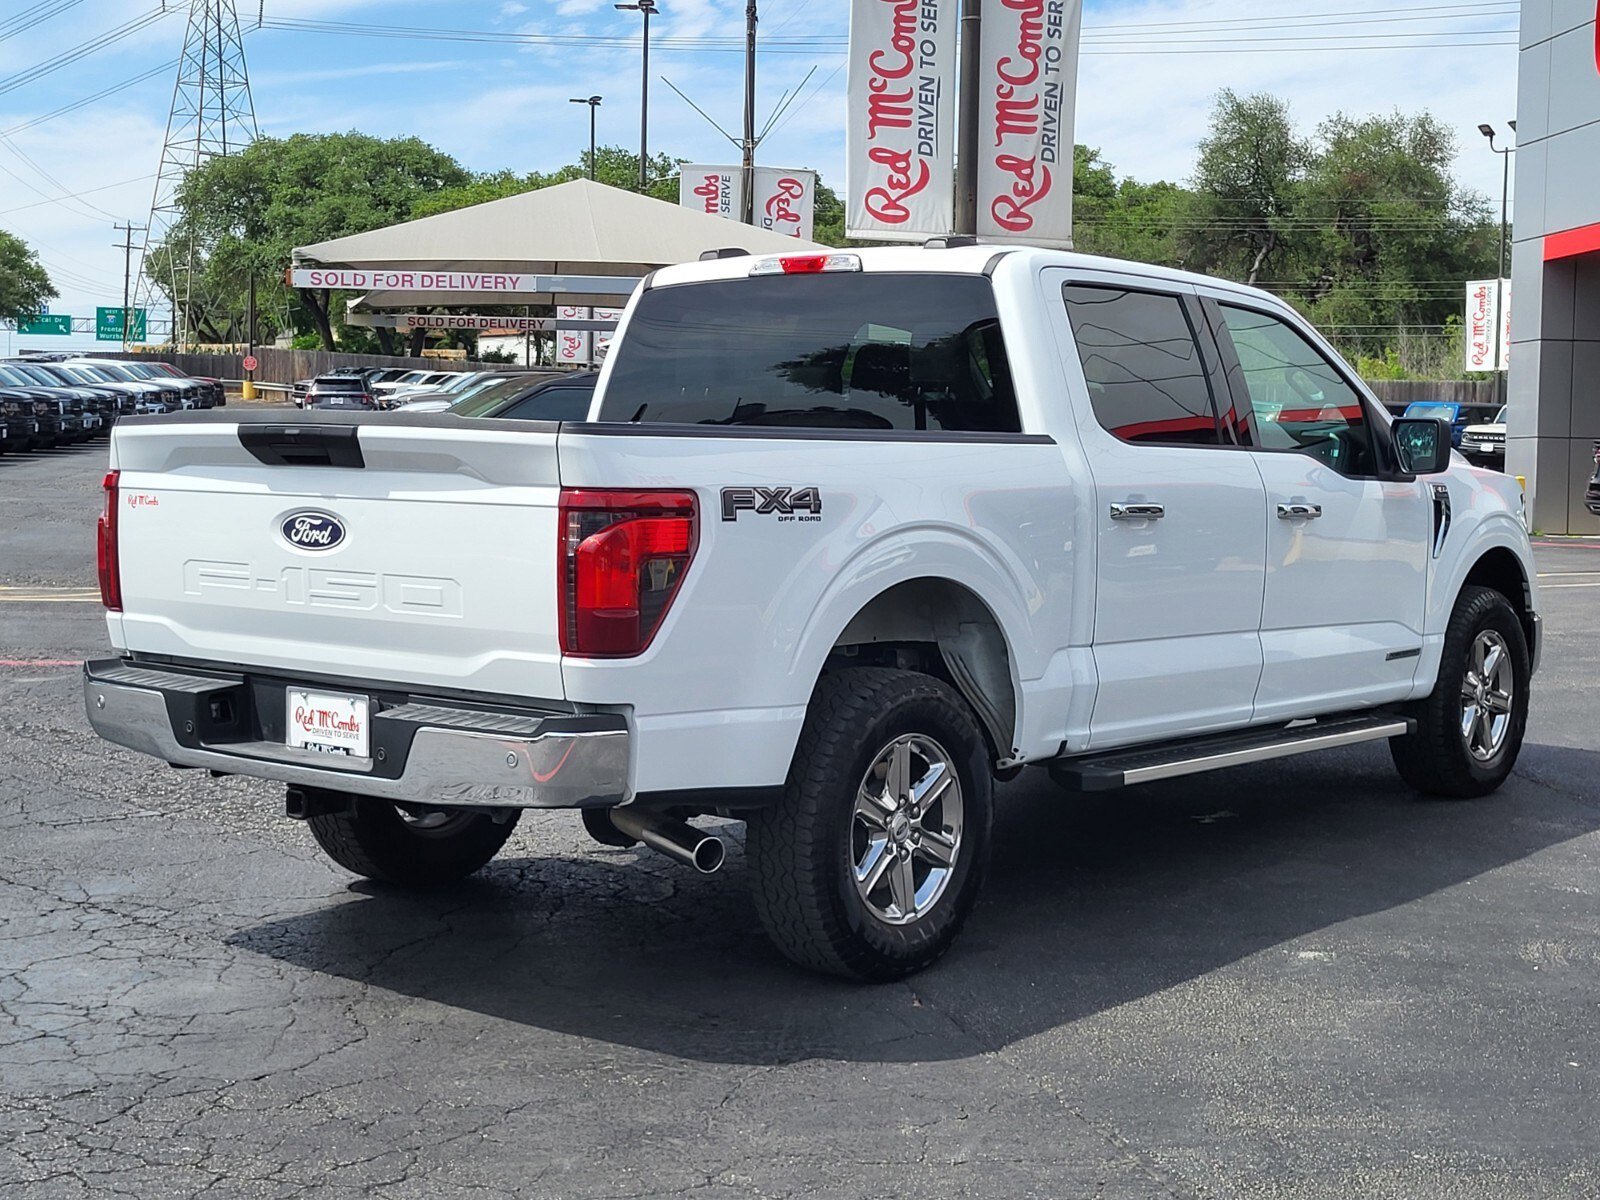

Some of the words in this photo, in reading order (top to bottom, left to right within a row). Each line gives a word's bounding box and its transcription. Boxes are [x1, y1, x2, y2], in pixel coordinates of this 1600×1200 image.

[867, 0, 918, 140] McCom
[919, 38, 937, 69] TO
[1044, 45, 1062, 76] TO
[917, 75, 936, 158] DRIVEN
[1040, 81, 1060, 164] DRIVEN
[720, 174, 731, 214] SERVE
[765, 178, 804, 222] Red
[865, 147, 930, 224] Red
[991, 154, 1052, 232] Red
[310, 271, 366, 287] SOLD
[373, 273, 414, 288] FOR
[420, 274, 521, 290] DELIVERY
[407, 316, 444, 327] SOLD
[448, 317, 476, 328] FOR
[480, 319, 546, 330] DELIVERY
[719, 486, 822, 522] FX4
[291, 516, 333, 544] Ford
[182, 558, 464, 619] F-150
[295, 705, 315, 732] Red
[316, 709, 360, 732] McCombs
[312, 728, 333, 736] DRIVEN
[334, 730, 342, 738] TO
[343, 732, 359, 740] SERVE
